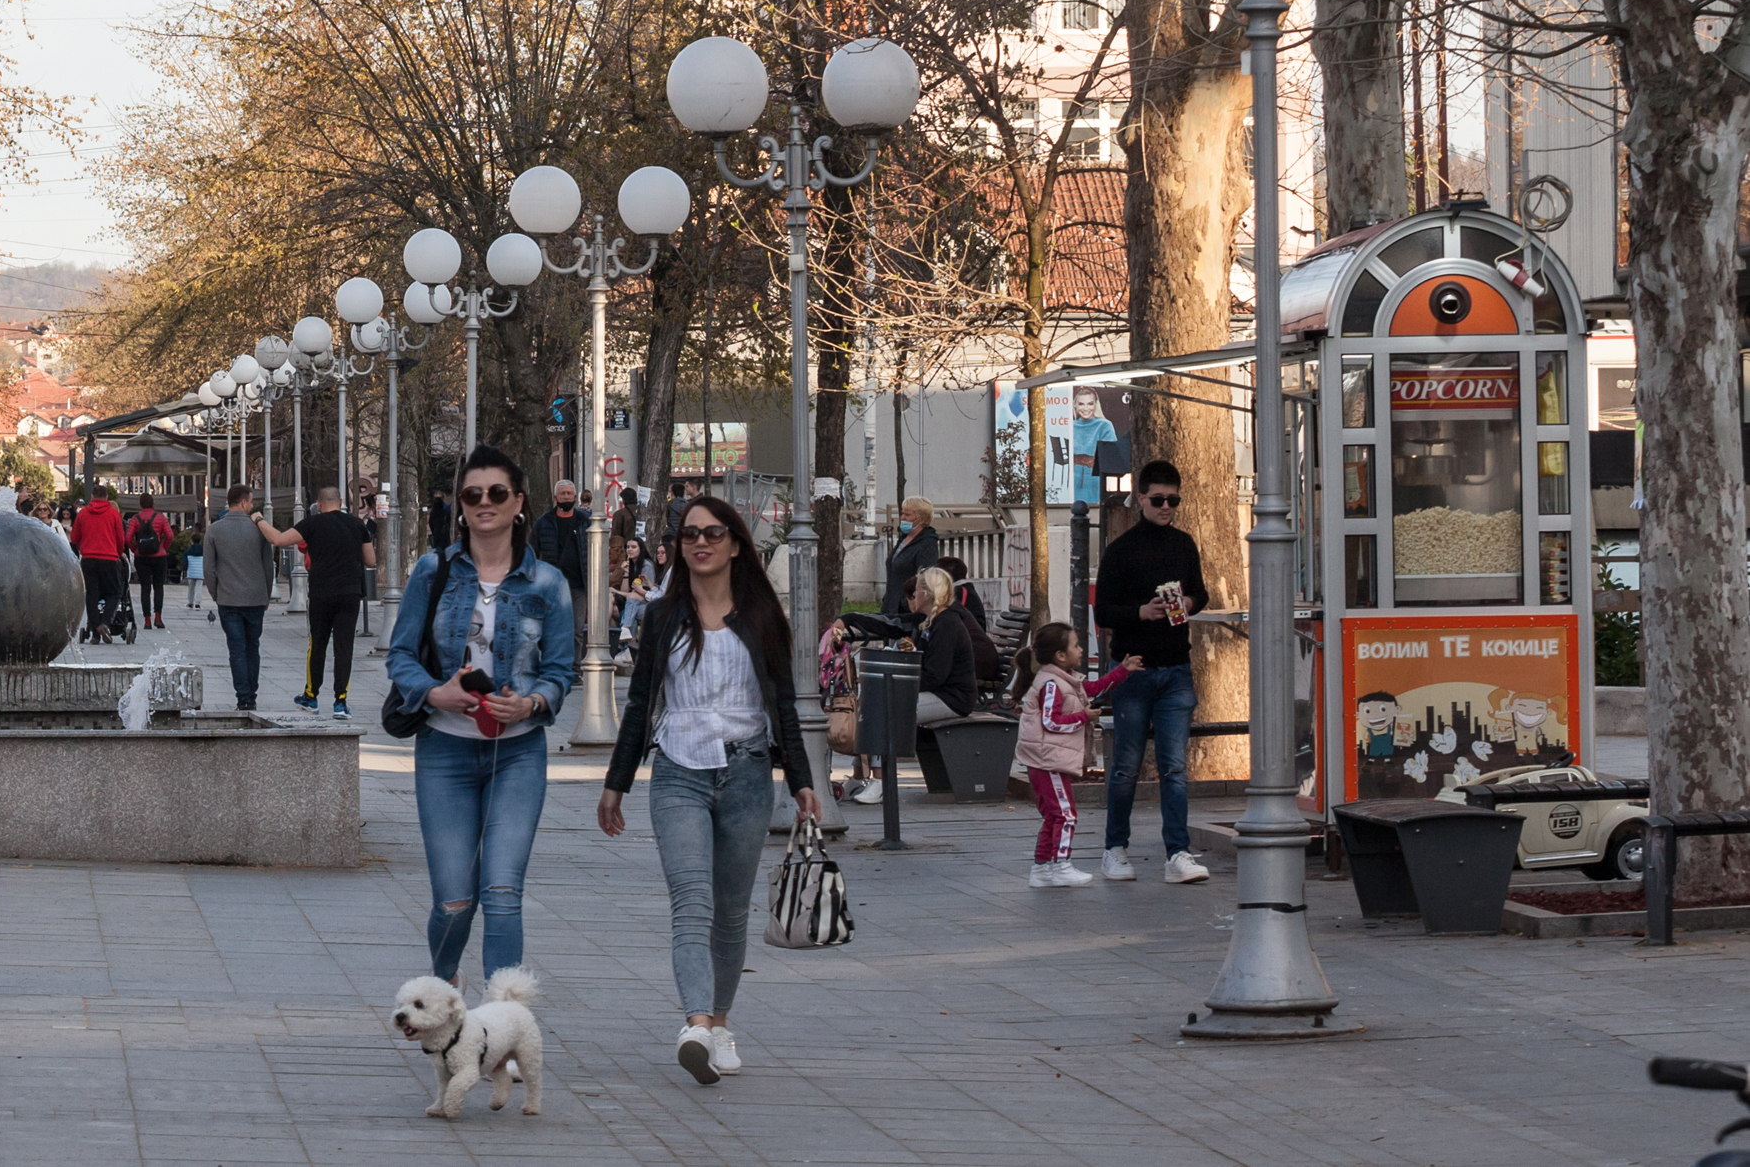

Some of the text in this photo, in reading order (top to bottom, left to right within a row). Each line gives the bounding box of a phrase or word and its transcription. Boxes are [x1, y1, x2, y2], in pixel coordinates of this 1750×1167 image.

[1358, 635, 1559, 660] ВОЛИМ ТЕ КОКИЦЕ
[1553, 817, 1579, 828] 158
